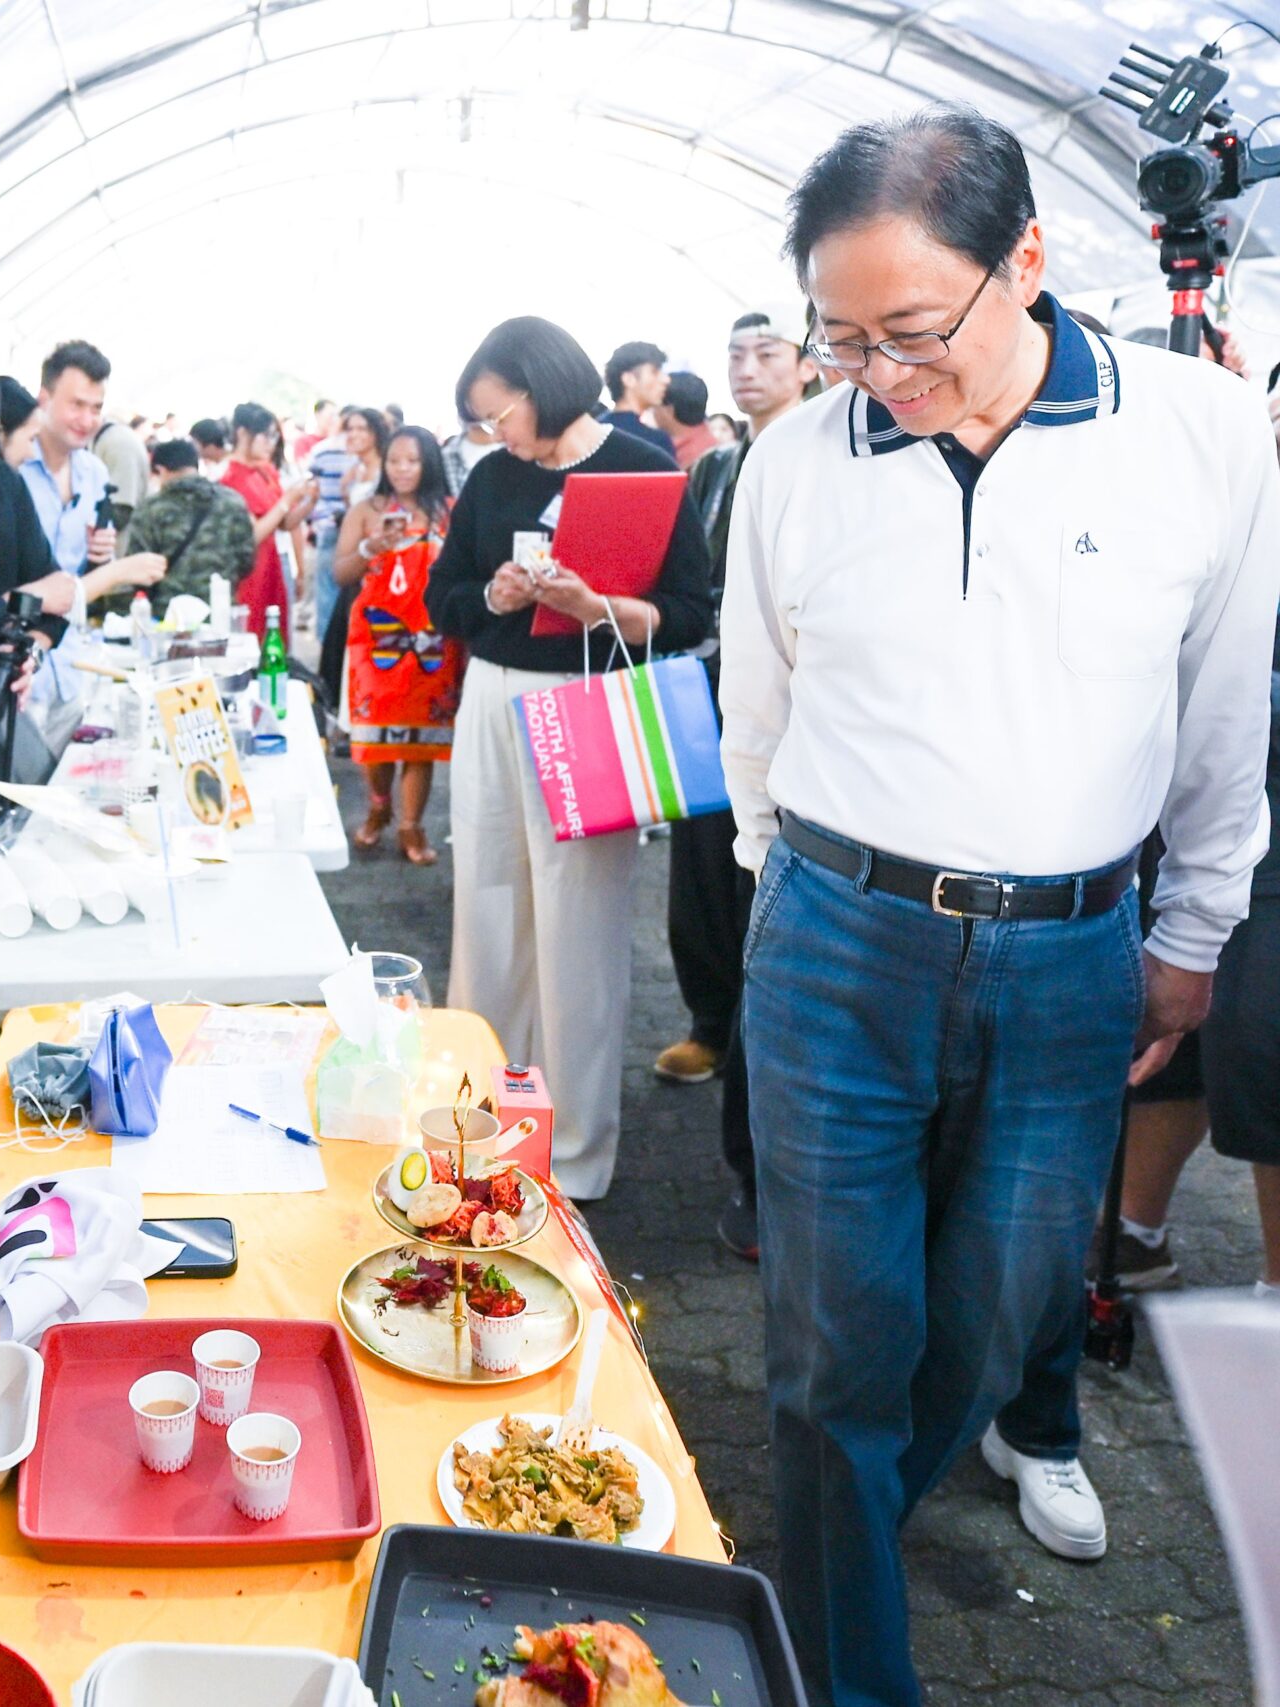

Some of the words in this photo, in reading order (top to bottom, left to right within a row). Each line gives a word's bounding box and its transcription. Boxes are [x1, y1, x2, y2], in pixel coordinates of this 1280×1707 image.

[174, 722, 229, 765] COFFEE
[523, 691, 554, 781] TAOYUAN
[540, 688, 566, 754] YOUTH
[554, 760, 586, 839] AFFAIRS
